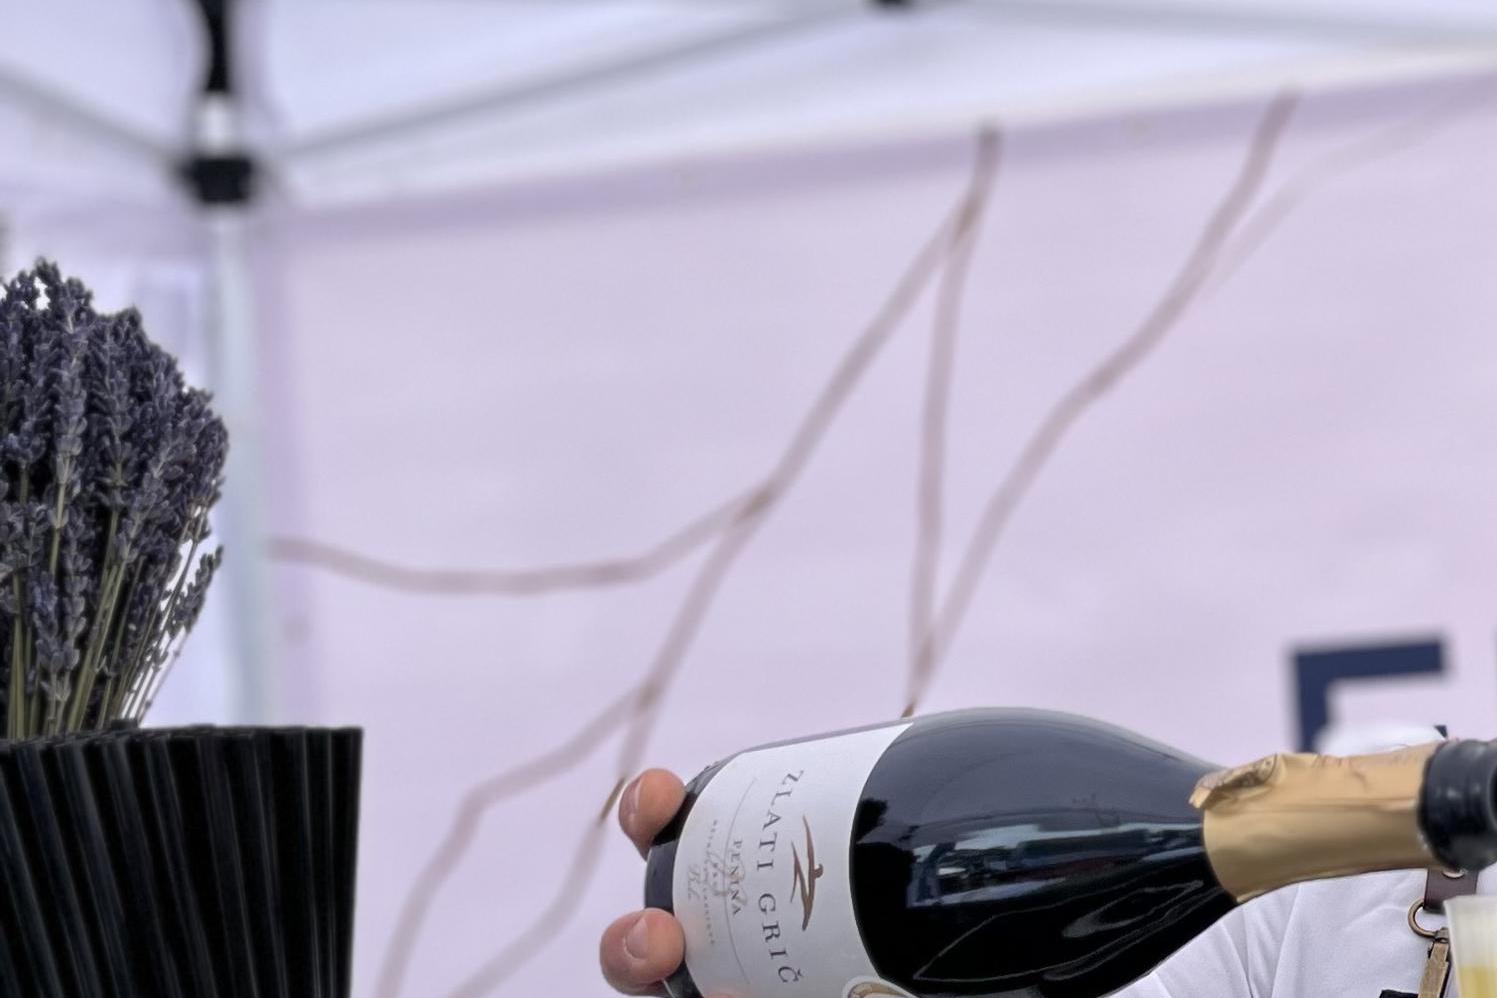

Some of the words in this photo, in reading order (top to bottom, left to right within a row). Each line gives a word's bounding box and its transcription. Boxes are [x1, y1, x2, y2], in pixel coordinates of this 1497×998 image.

[756, 769, 805, 871] ZLATI
[730, 837, 744, 916] PENINA
[757, 893, 805, 984] GRIČ
